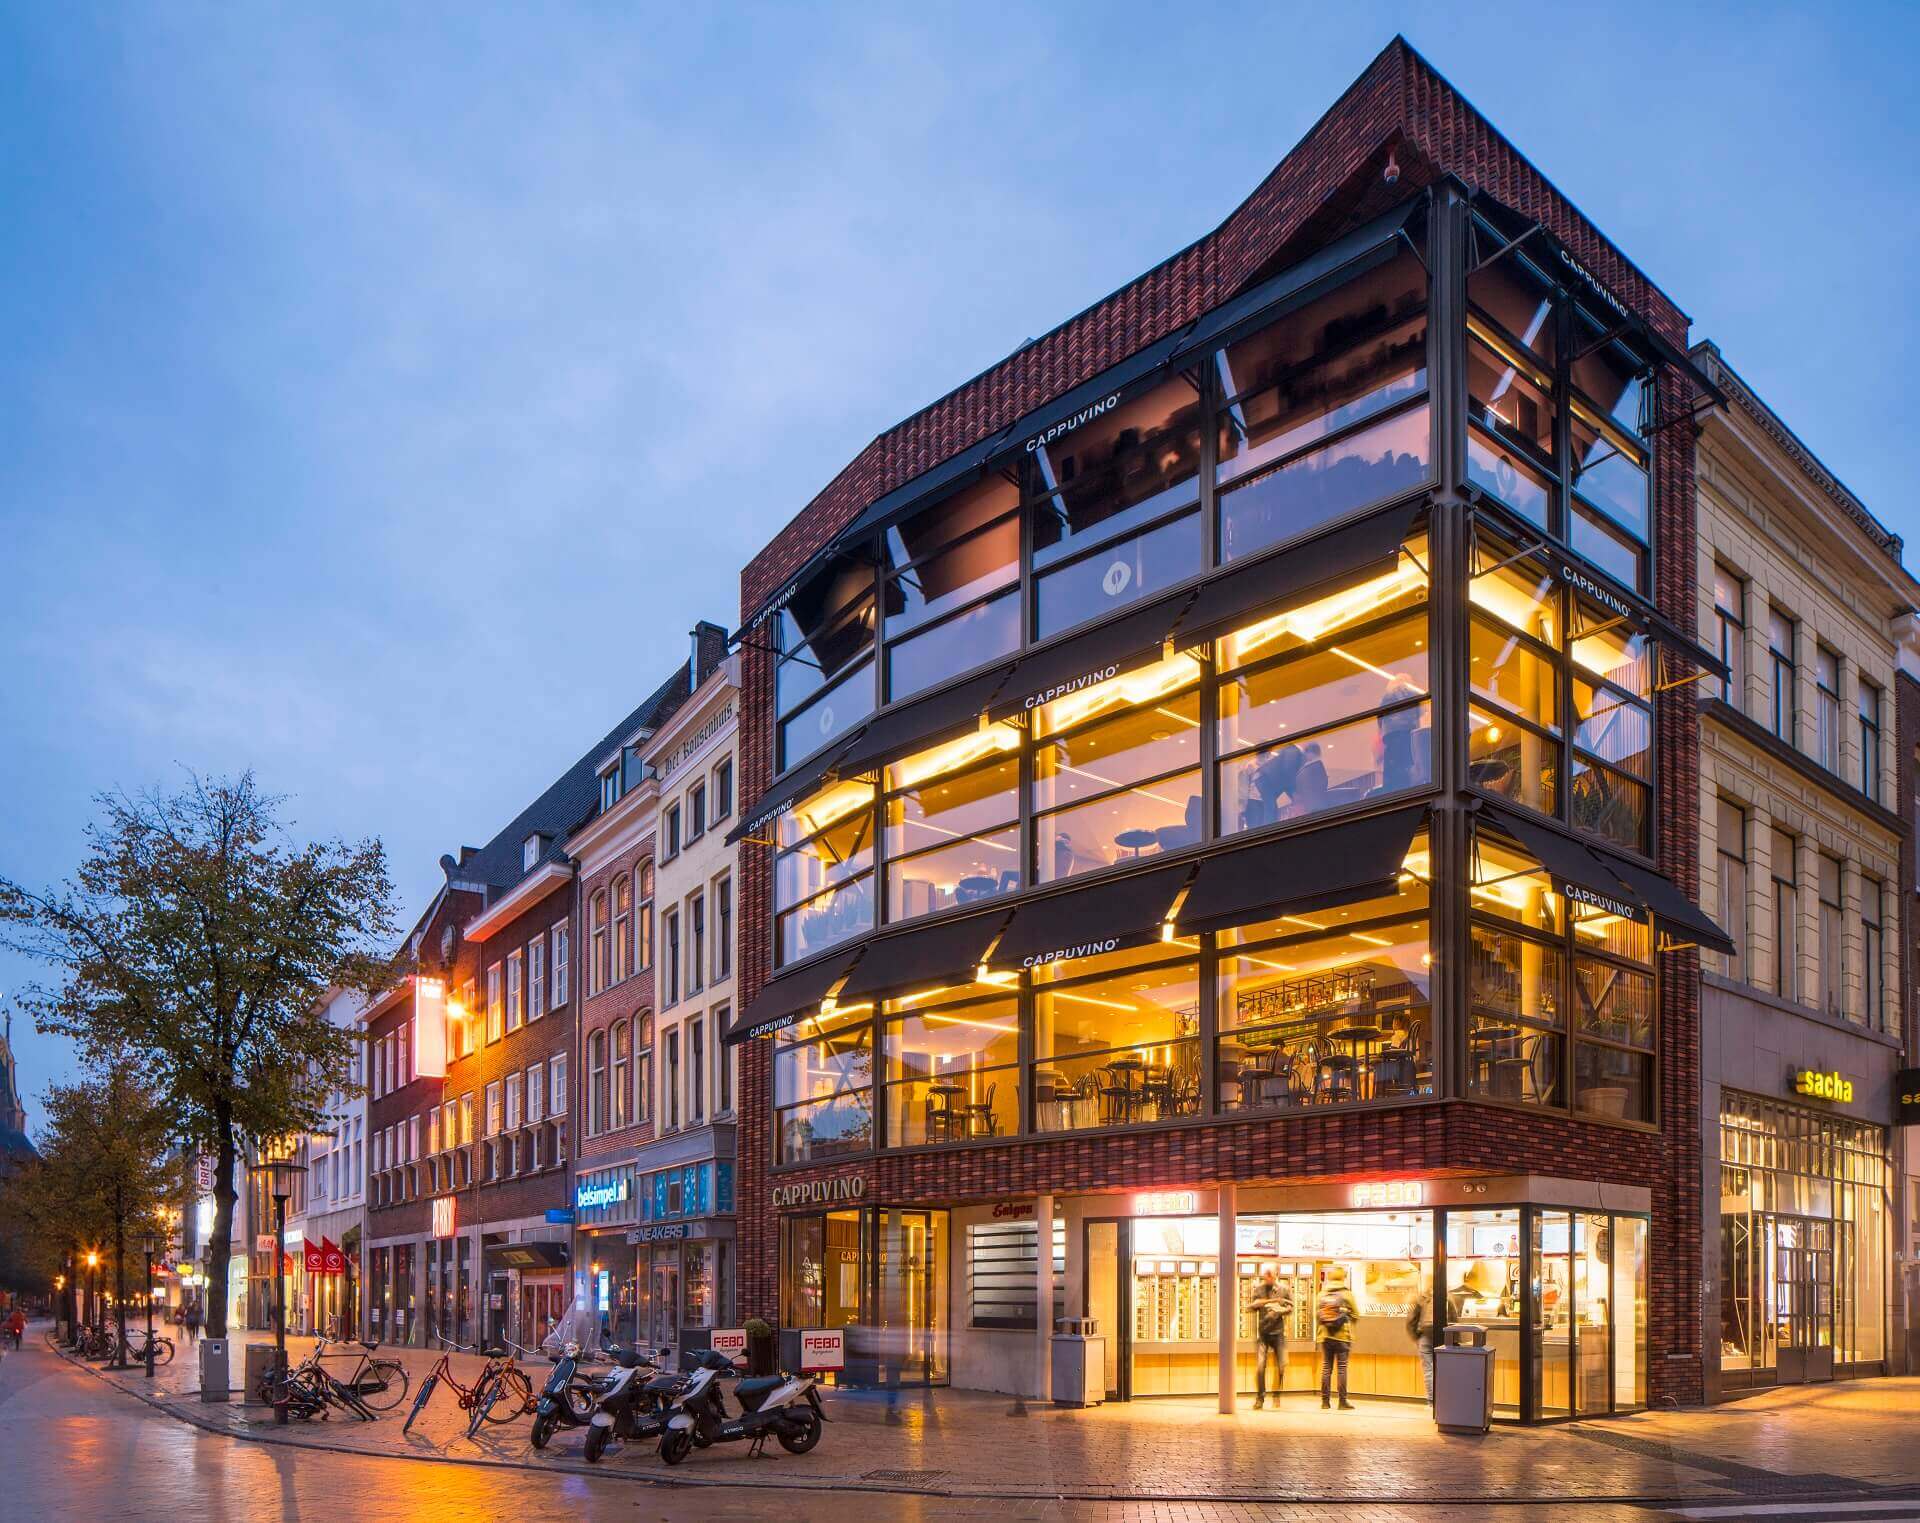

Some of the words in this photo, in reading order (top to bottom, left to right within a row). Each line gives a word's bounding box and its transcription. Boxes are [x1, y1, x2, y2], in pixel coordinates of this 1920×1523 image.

[1561, 250, 1627, 318] CAPPUVINO
[1026, 394, 1119, 452] CAPPUVINO
[752, 583, 797, 628] CAPPUVINO
[1563, 566, 1630, 617] CAPPUVINO
[1025, 664, 1118, 708] CAPPUVINO
[749, 798, 793, 832] CAPPUVINO
[1565, 884, 1633, 918] CAPPUVINO
[1023, 939, 1119, 967] CAPPUVINO
[749, 1014, 794, 1038] CAPPUVINO
[1804, 1070, 1853, 1103] sacha
[578, 1178, 627, 1210] belsimpel.nl
[772, 1176, 864, 1207] CAPPUVINO
[634, 1224, 684, 1242] SNEAKERS
[713, 1335, 744, 1348] FEBO
[804, 1337, 841, 1350] FEBO
